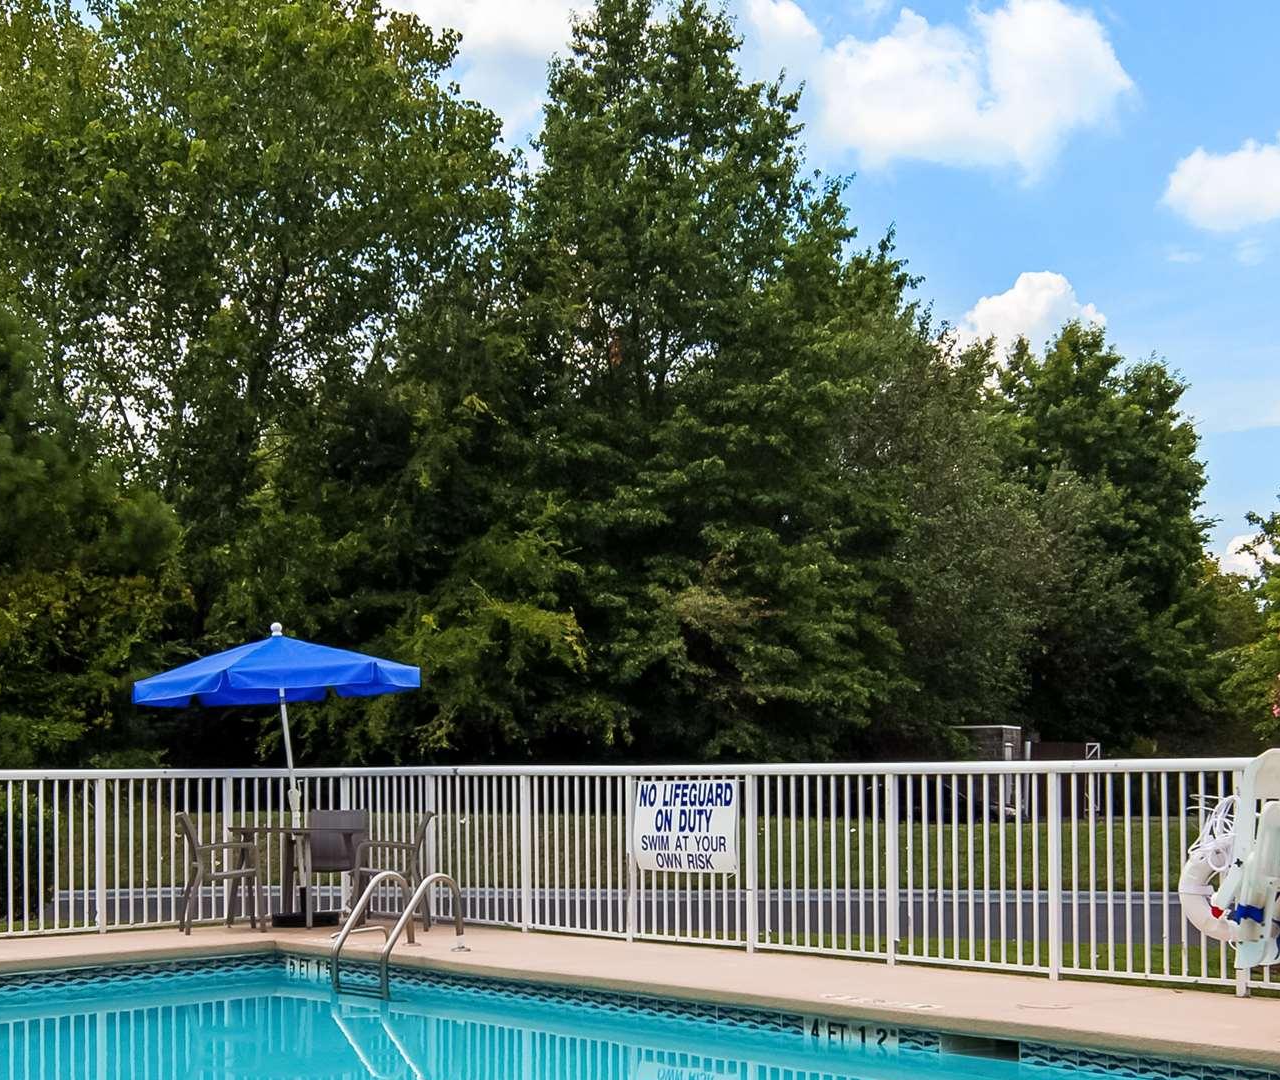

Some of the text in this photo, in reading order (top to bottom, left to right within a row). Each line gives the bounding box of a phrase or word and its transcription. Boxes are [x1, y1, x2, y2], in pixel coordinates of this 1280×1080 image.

[640, 783, 733, 807] NO LIFEGUARD
[655, 809, 713, 832] ON DUTY
[641, 835, 726, 852] SWIM AT YOUR
[656, 853, 714, 870] OWN RISK
